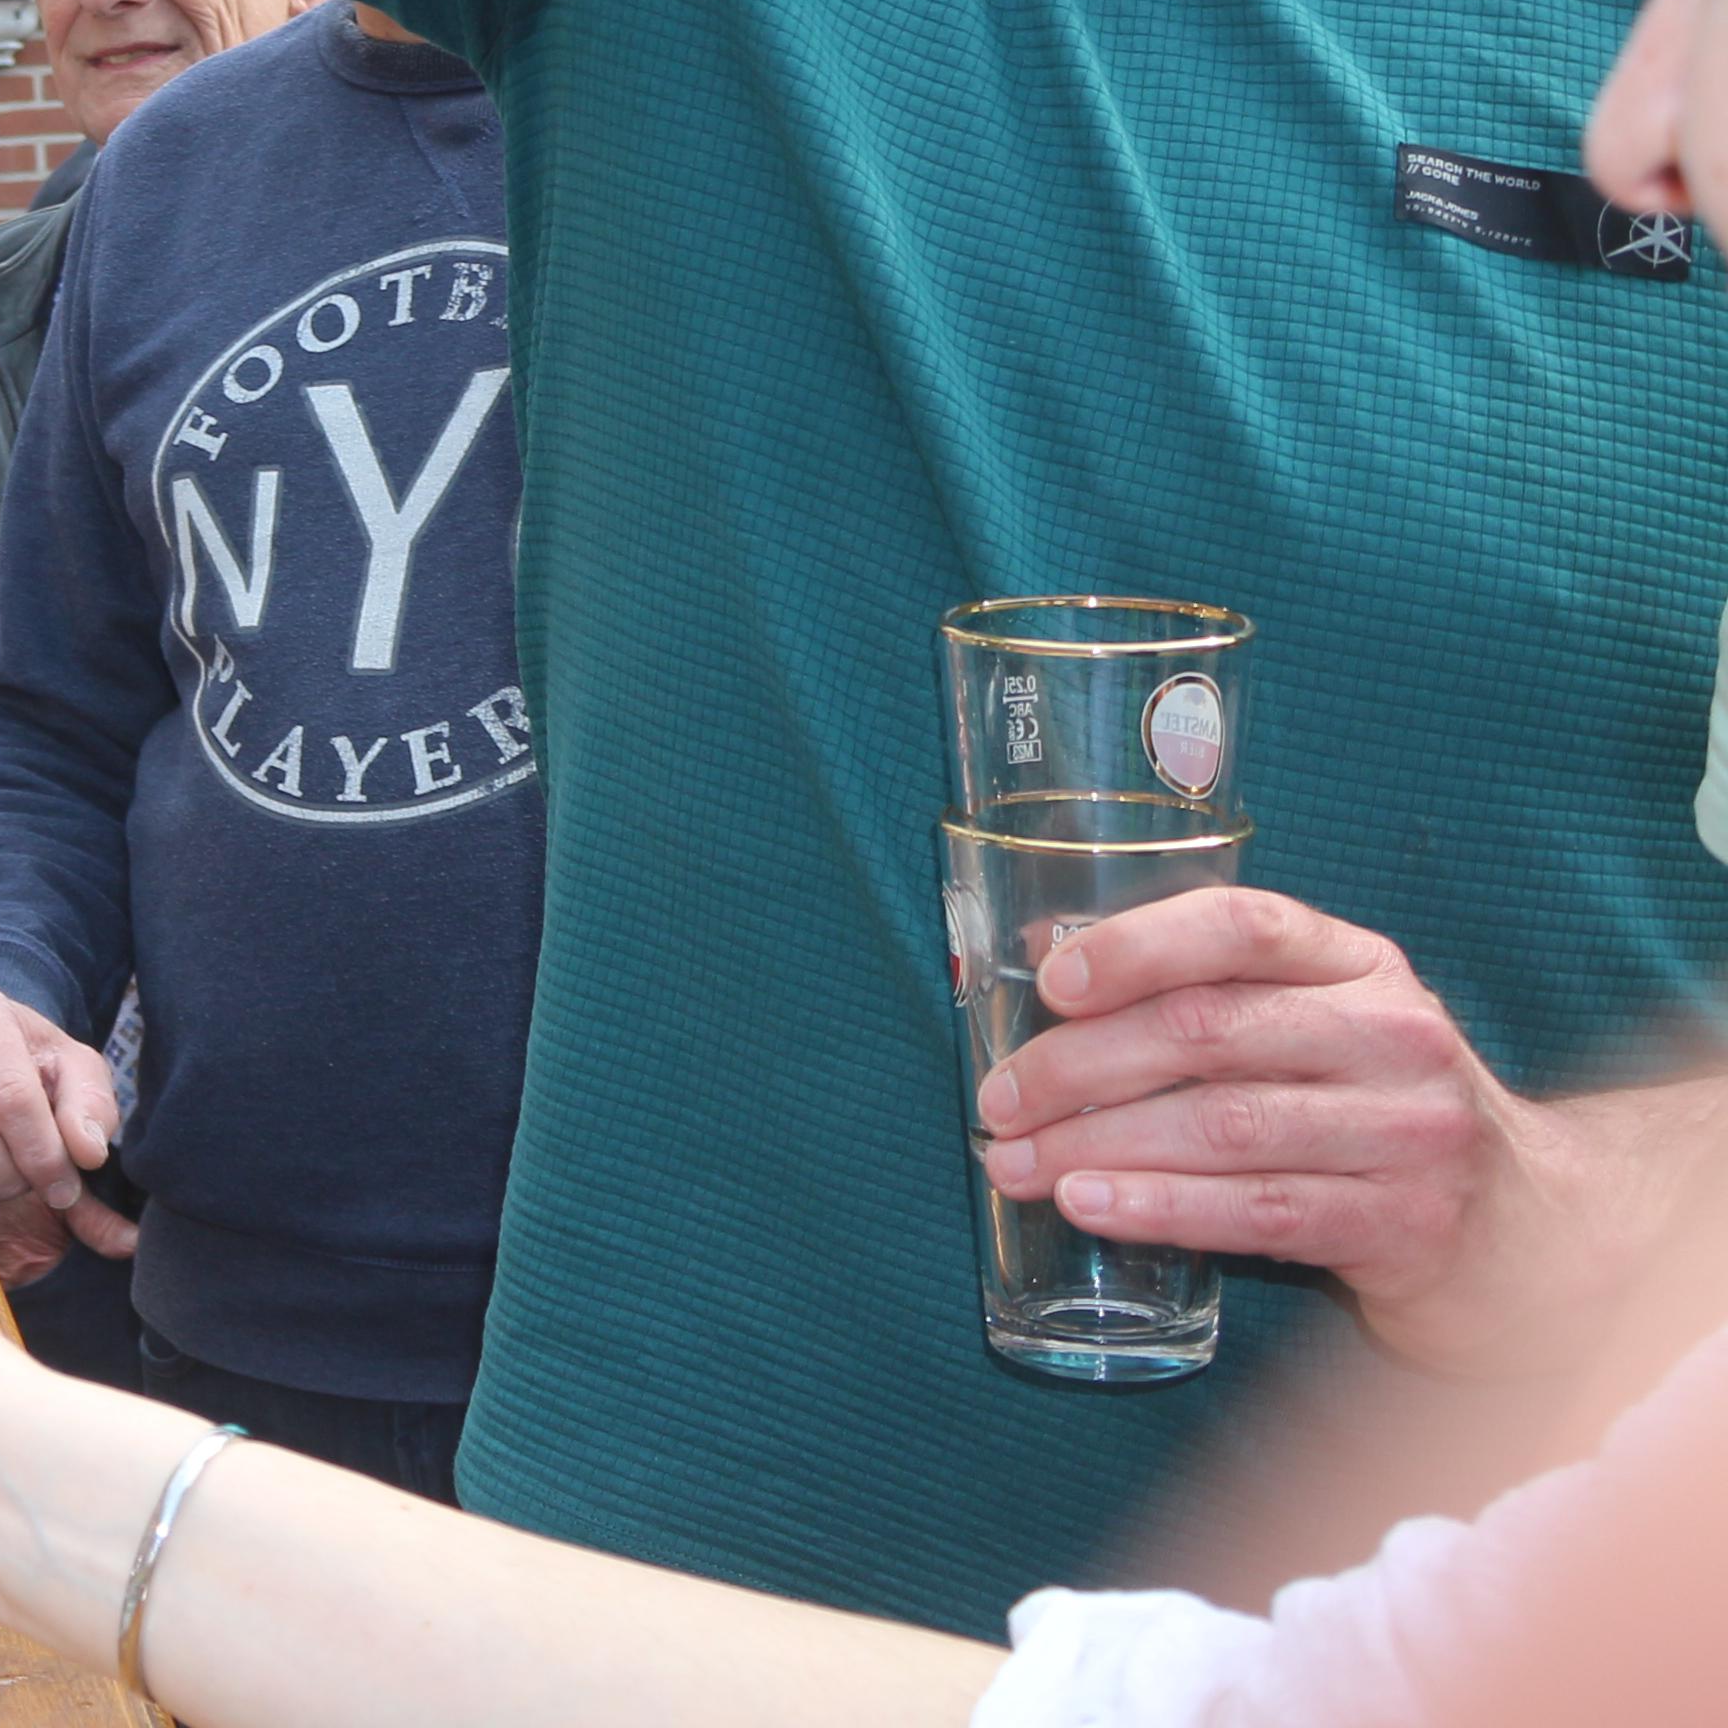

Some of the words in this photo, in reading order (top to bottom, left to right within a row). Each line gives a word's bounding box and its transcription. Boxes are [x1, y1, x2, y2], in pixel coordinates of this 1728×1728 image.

[1406, 153, 1464, 175] SEARCH
[1466, 167, 1493, 185] THE
[1494, 174, 1542, 191] WORLD
[1421, 165, 1461, 187] CORE
[172, 261, 510, 462] FOOTB
[171, 366, 513, 671] NY
